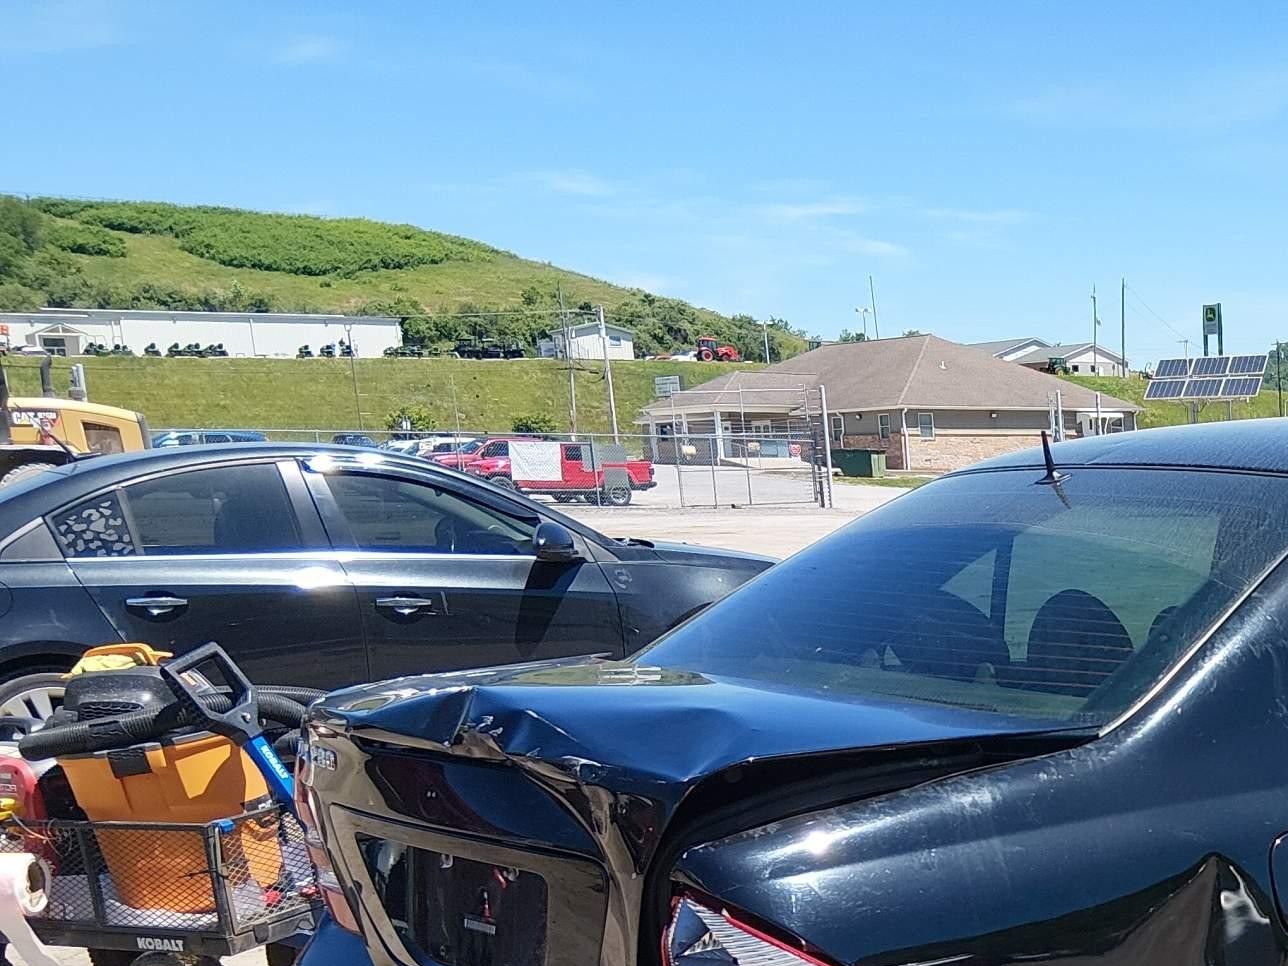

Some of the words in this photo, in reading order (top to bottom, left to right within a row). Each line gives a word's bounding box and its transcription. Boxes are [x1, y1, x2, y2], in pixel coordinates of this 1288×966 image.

[12, 411, 36, 425] CAT
[260, 744, 289, 779] KOBALT
[136, 937, 184, 951] KOBALT
